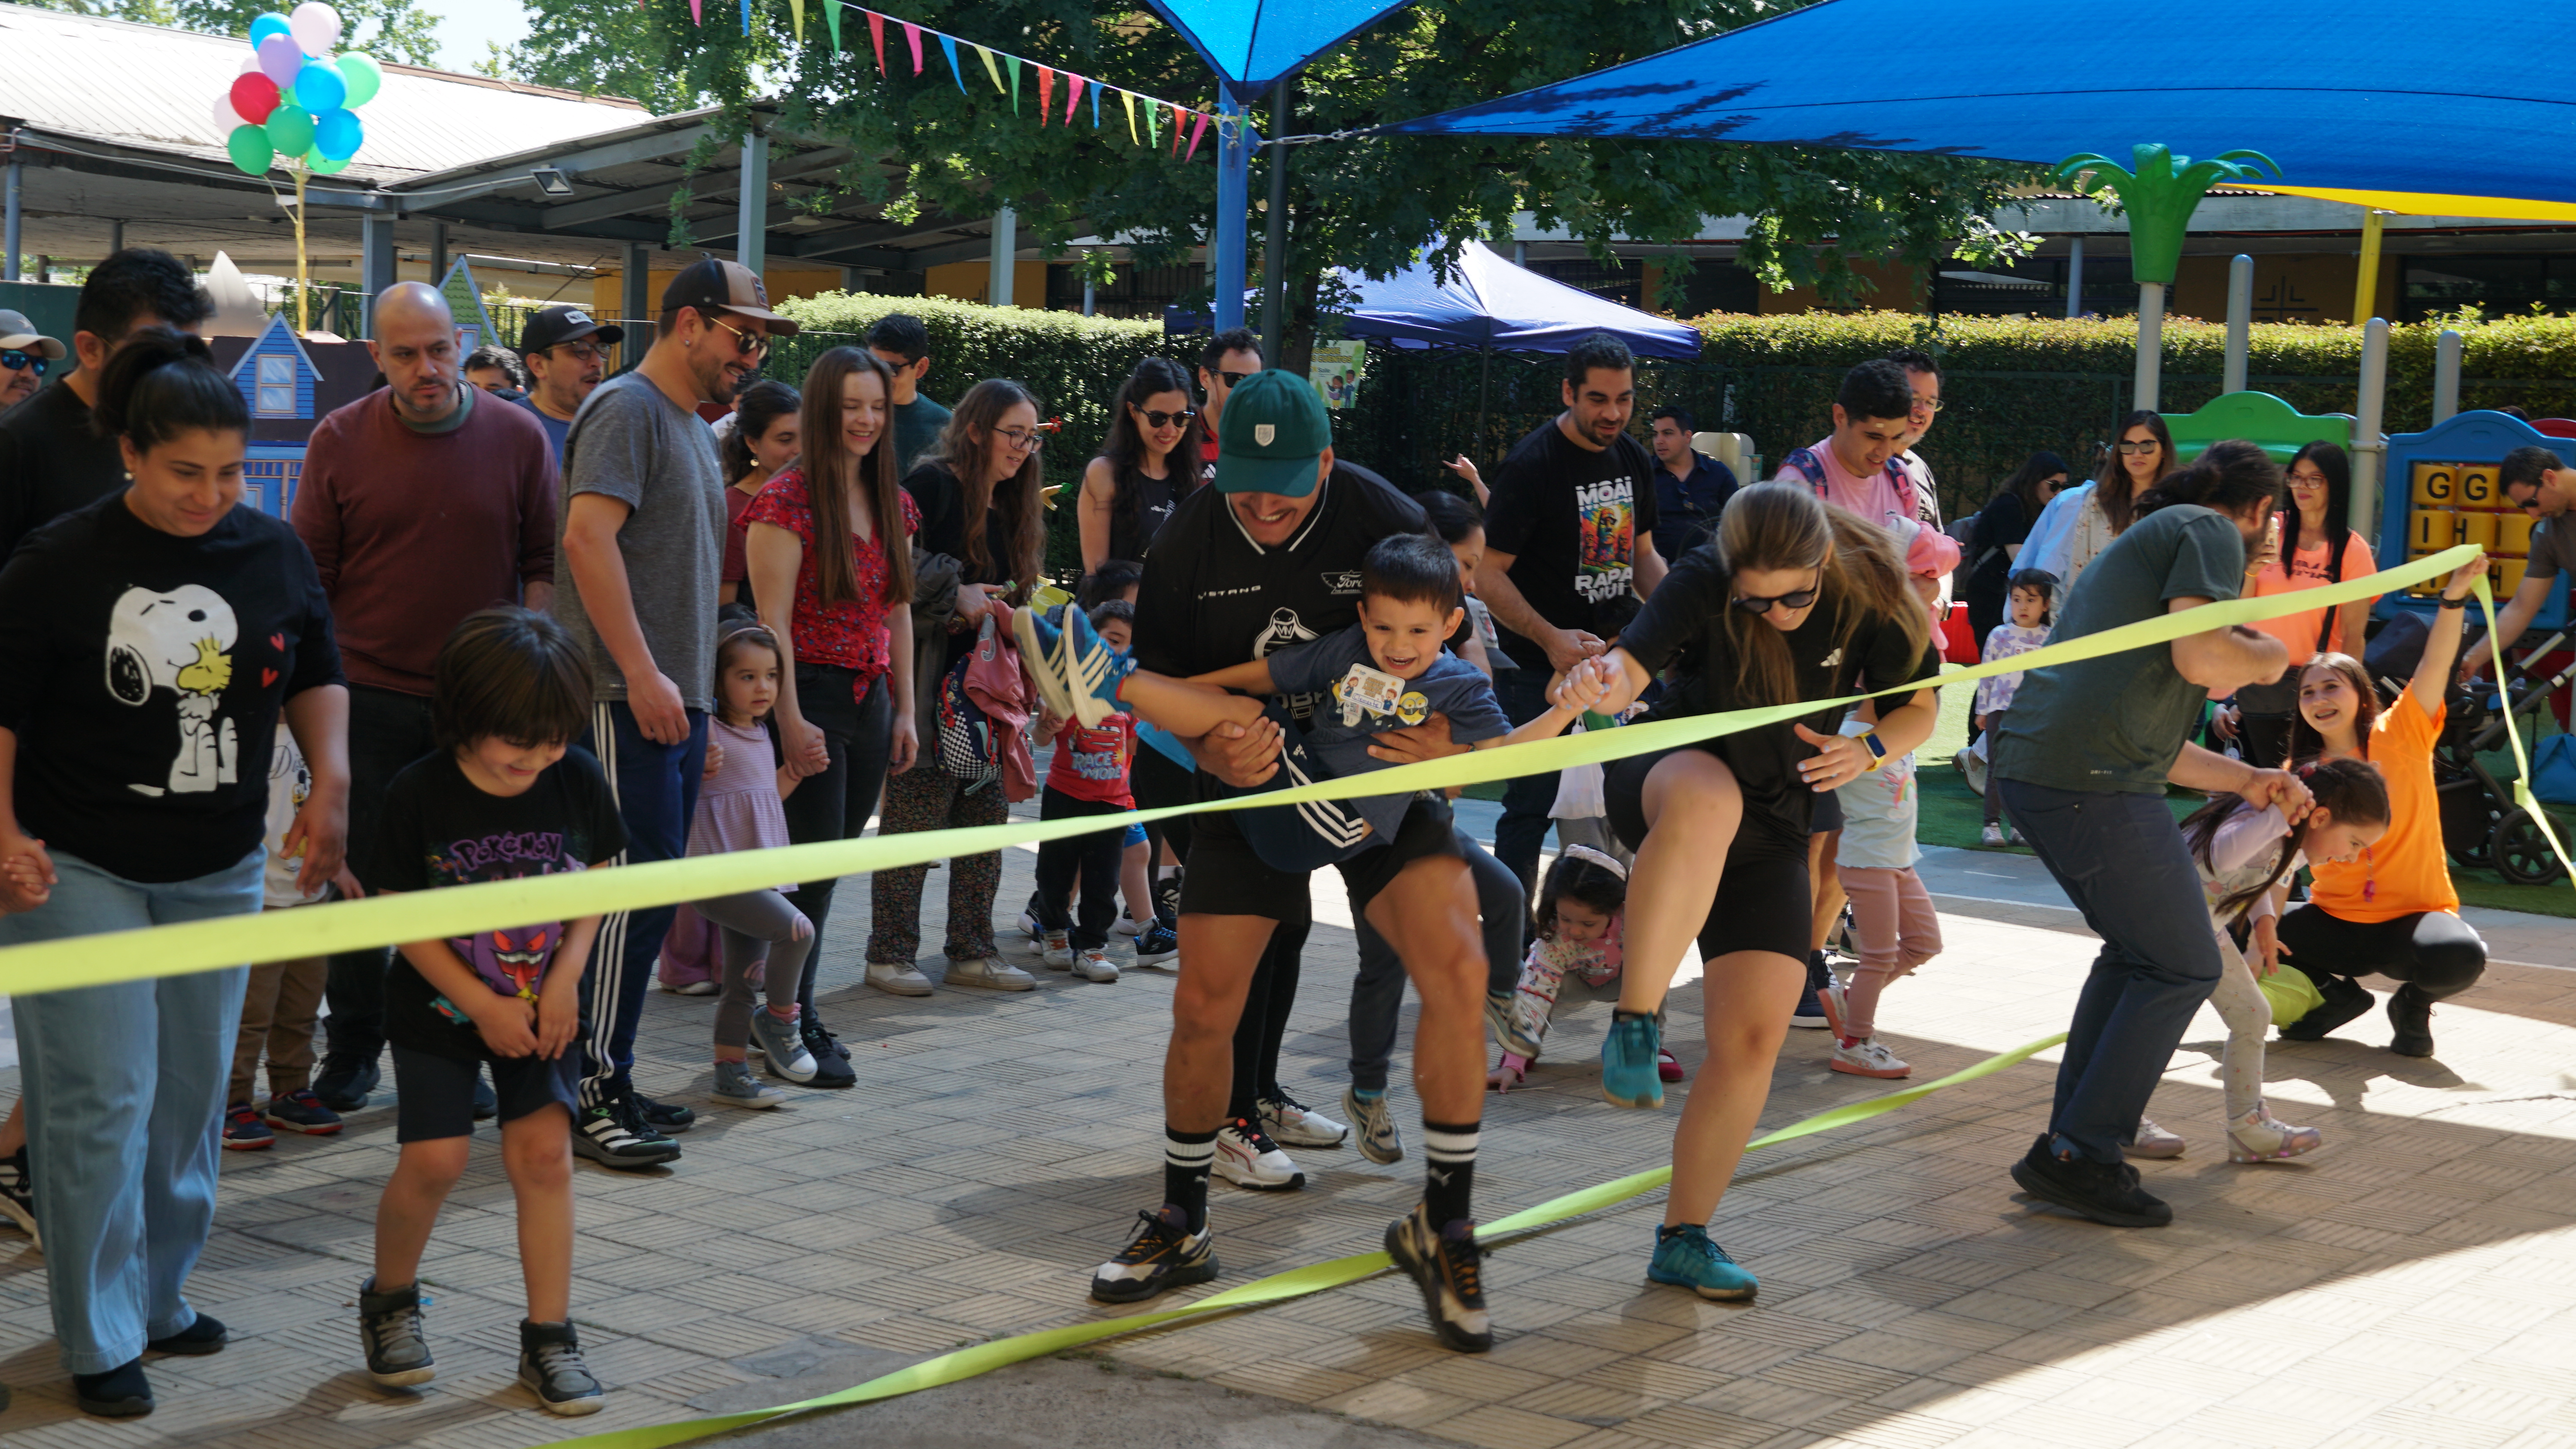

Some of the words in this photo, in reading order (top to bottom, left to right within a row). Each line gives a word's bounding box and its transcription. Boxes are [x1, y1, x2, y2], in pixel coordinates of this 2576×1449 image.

[1575, 475, 1634, 512] MOAI
[2427, 472, 2450, 499] G
[2465, 474, 2488, 501] G
[1575, 567, 1634, 591] RAPA
[1588, 582, 1625, 604] NUI
[1354, 694, 1379, 708] Clemente
[1070, 750, 1114, 772] RACE
[1079, 764, 1122, 780] MODE
